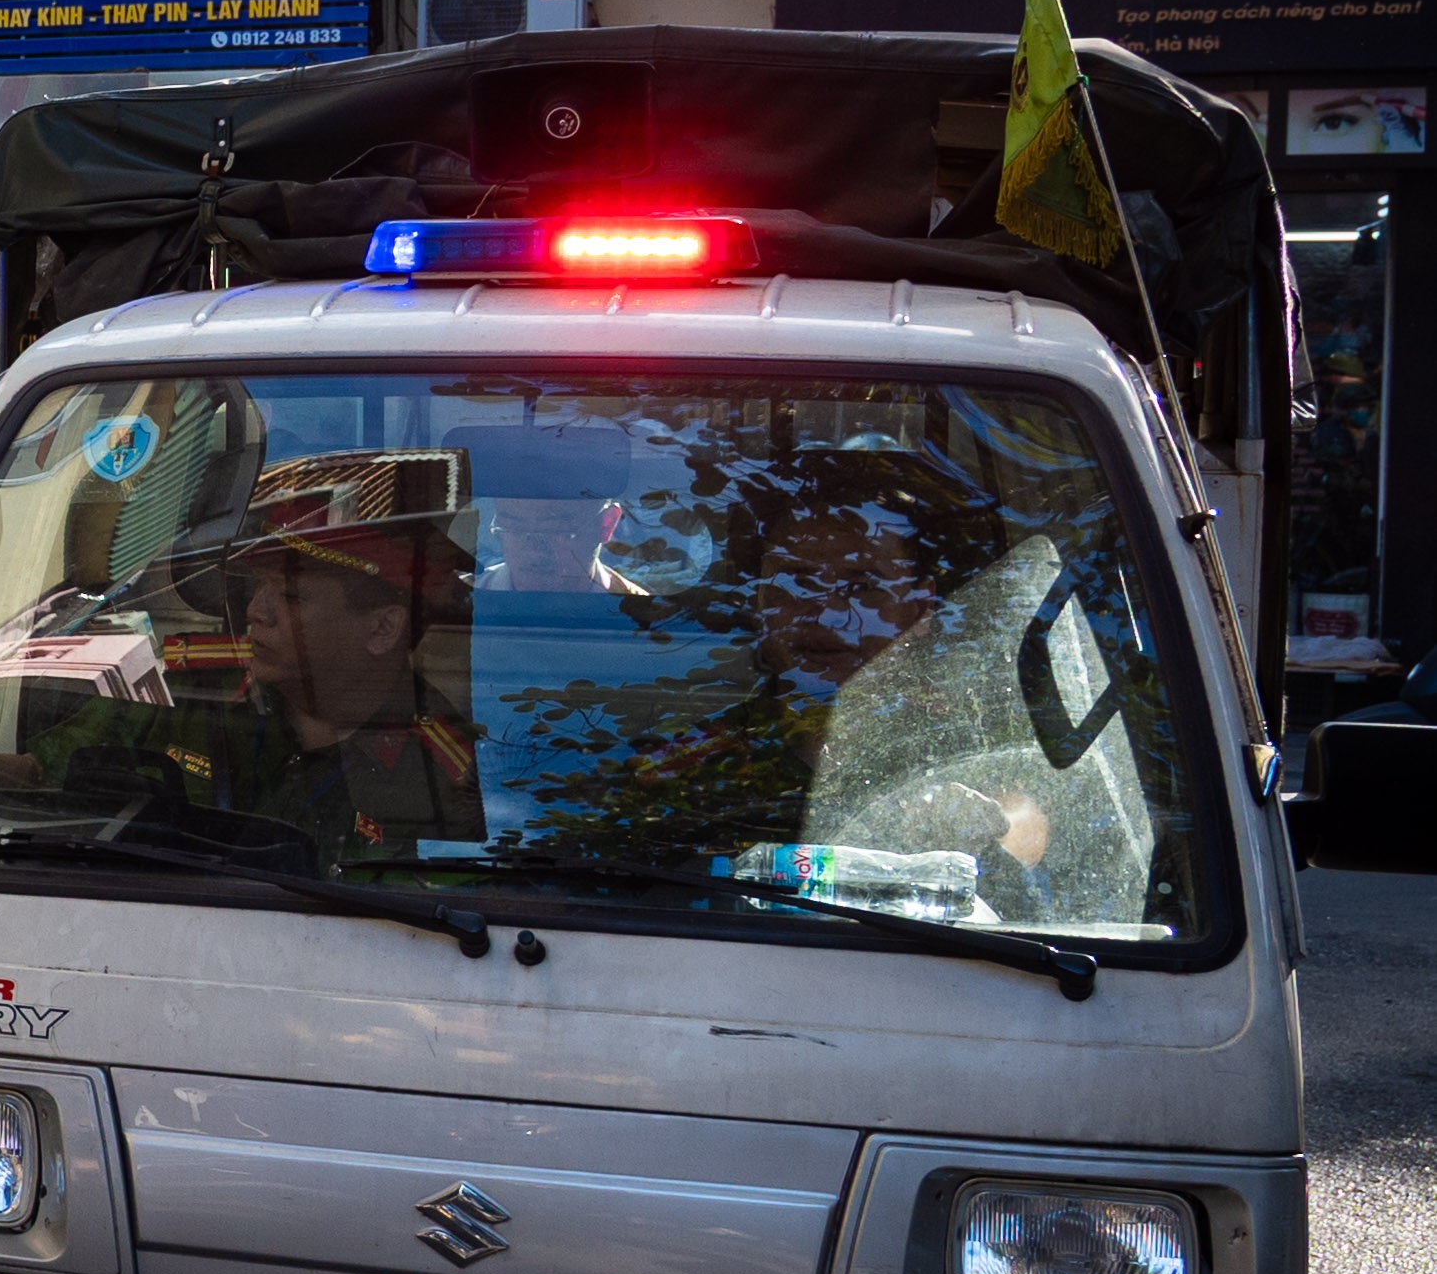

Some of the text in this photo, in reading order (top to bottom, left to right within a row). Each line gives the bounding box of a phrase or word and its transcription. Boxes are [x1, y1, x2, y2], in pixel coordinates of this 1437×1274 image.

[37, 1, 83, 27] KÍNH
[102, 3, 147, 24] THAY
[153, 2, 188, 22] PIN
[1116, 9, 1150, 26] Tạo
[1156, 8, 1217, 23] phong
[1222, 1, 1270, 19] cách
[1331, 2, 1367, 16] cho
[232, 29, 341, 46] 0912 248 833
[1155, 34, 1182, 51] Hà
[1188, 34, 1220, 53] Nội
